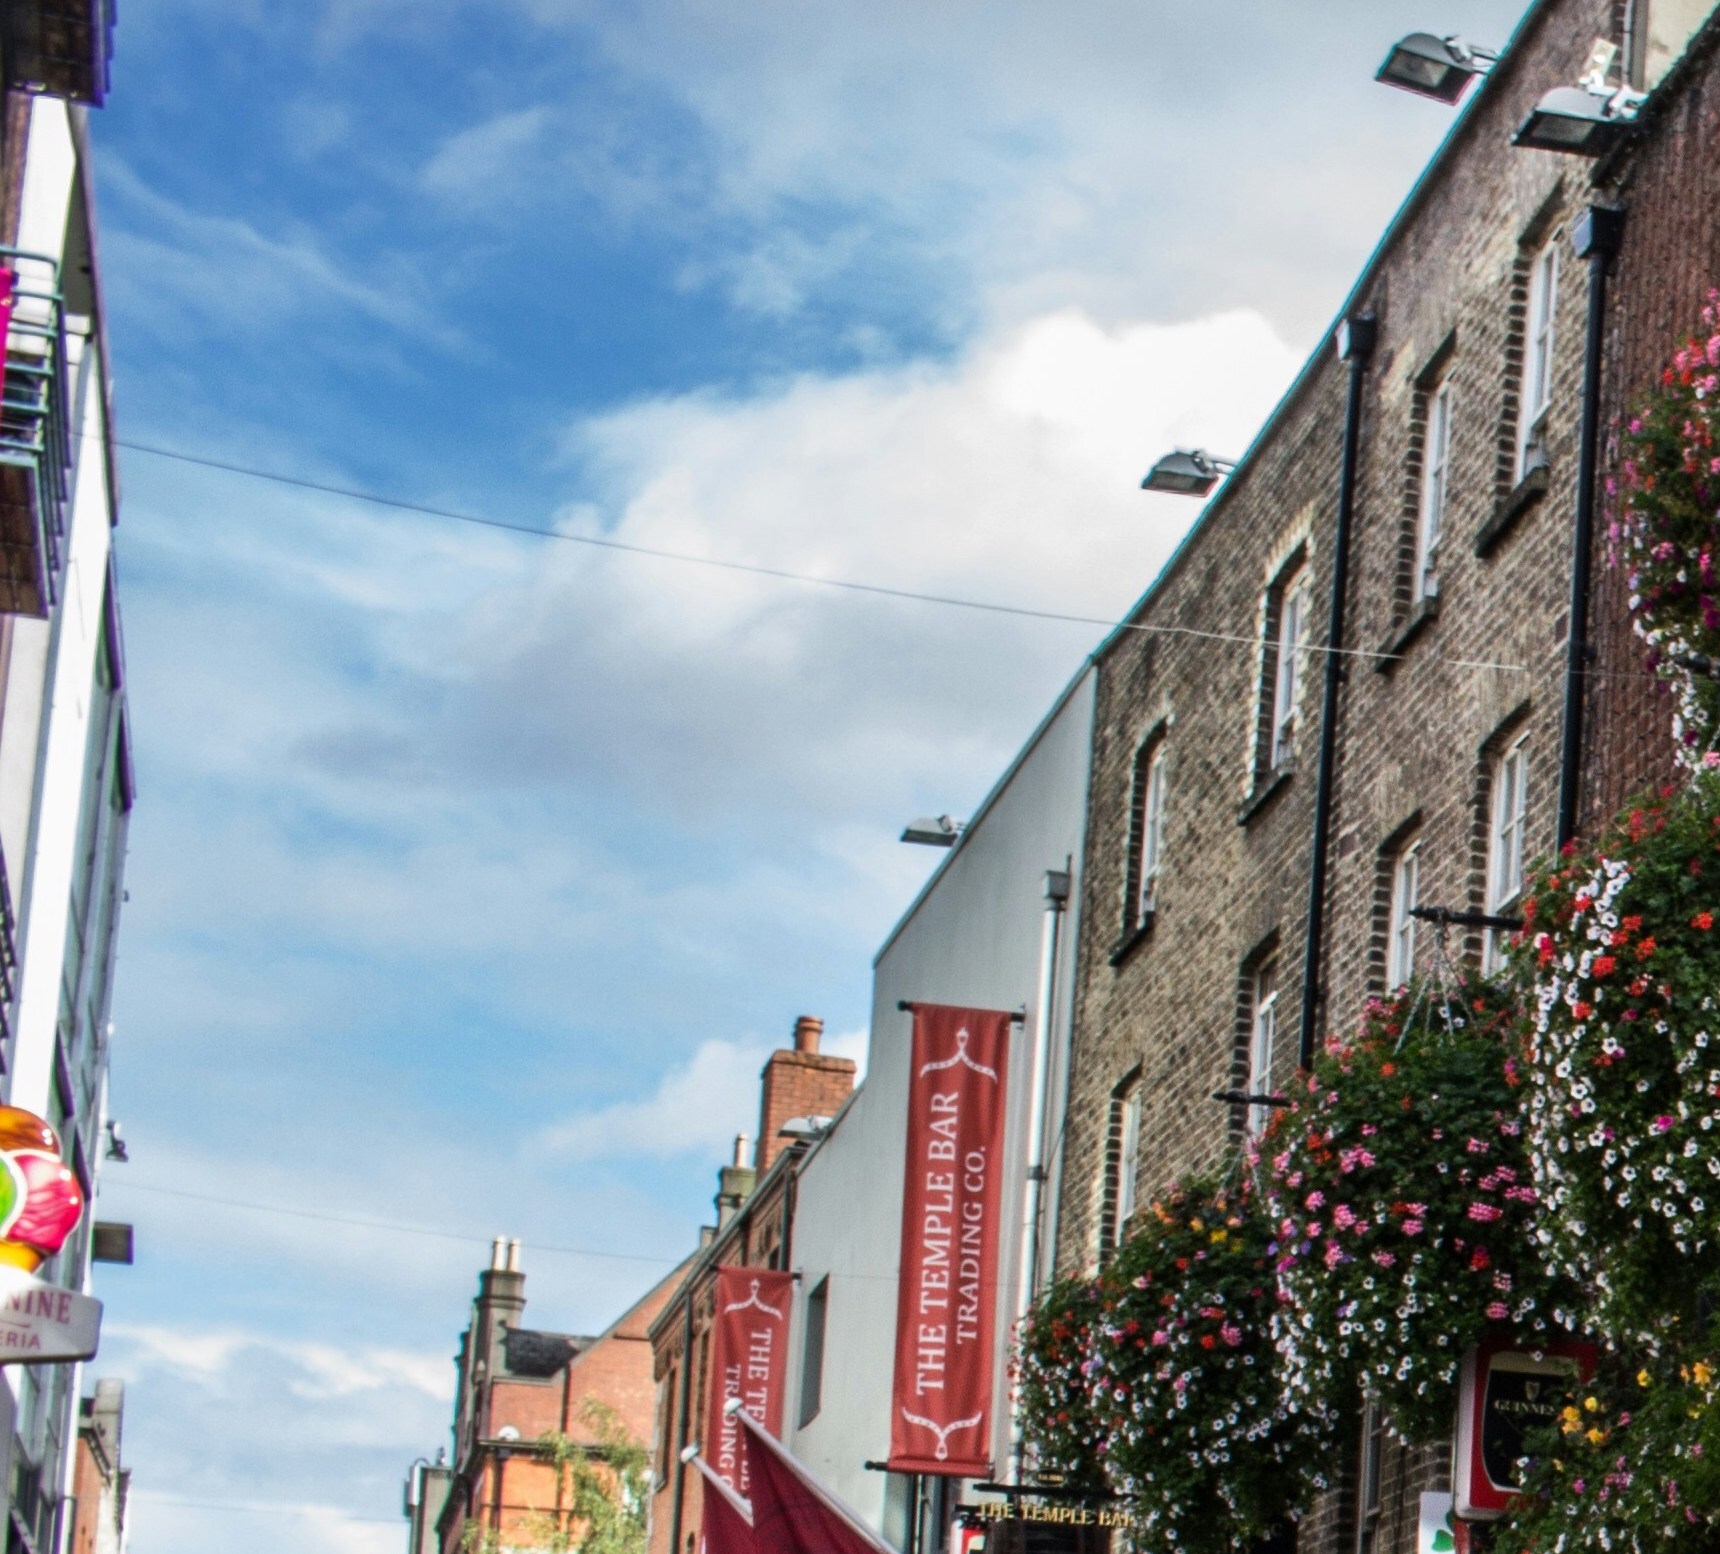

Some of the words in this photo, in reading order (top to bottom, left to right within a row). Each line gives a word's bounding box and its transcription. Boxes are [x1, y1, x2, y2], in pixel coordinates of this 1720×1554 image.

[928, 1091, 959, 1161] BAR
[964, 1146, 986, 1192] CO.
[920, 1171, 954, 1314] TEMPLE
[956, 1201, 983, 1345] TRADING
[0, 1330, 41, 1349] RIA
[748, 1327, 772, 1380] THE
[916, 1323, 946, 1395] THE
[720, 1364, 741, 1469] TRDING
[1495, 1400, 1556, 1415] GUINNES
[976, 1503, 1014, 1519] THE
[1021, 1504, 1094, 1524] TEMPLE
